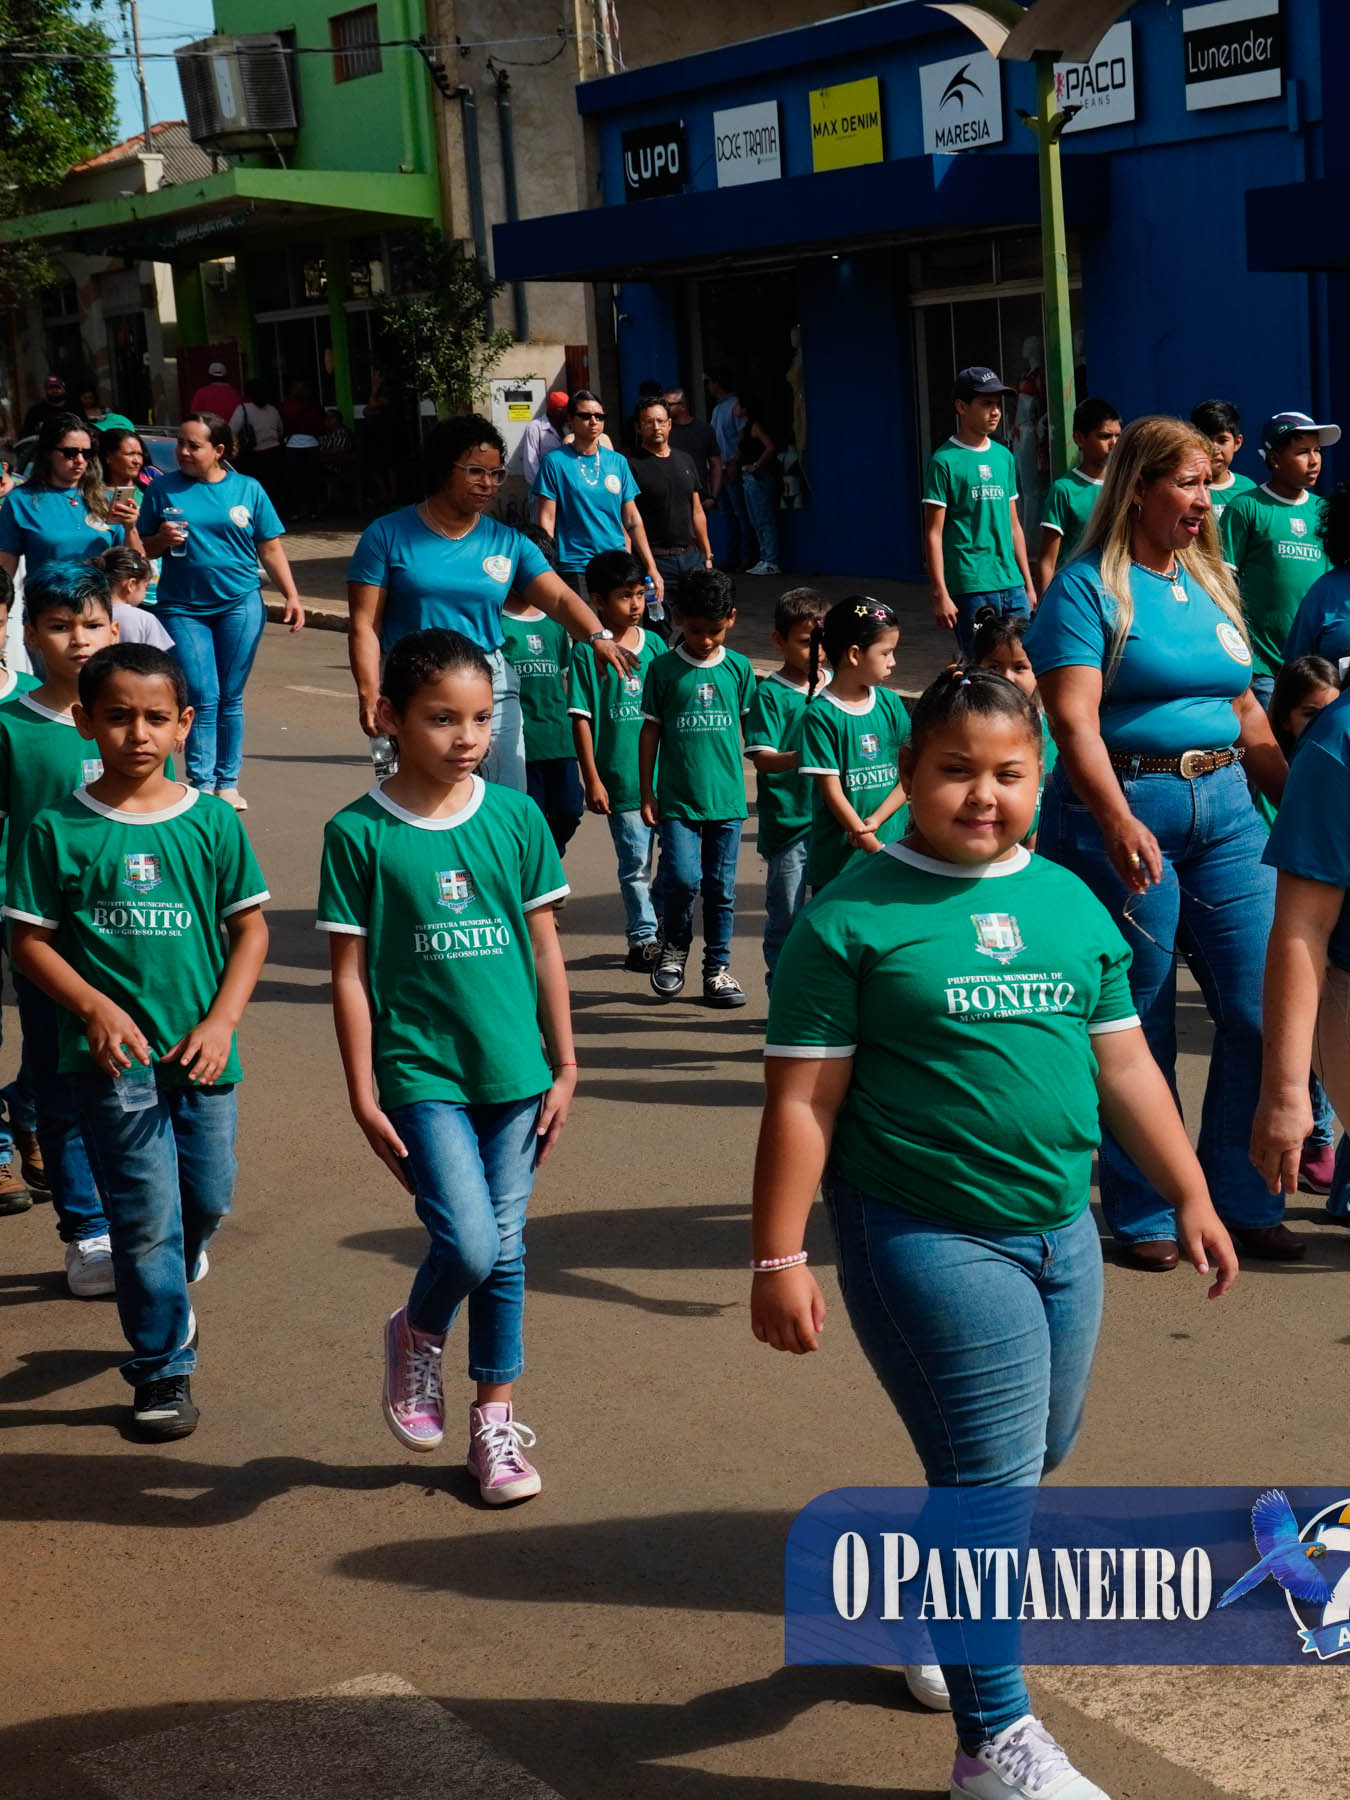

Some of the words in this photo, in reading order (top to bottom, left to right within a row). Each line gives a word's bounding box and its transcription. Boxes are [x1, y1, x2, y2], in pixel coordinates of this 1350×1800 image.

[1188, 30, 1273, 73] Lunender
[1065, 57, 1126, 100] PACO
[813, 116, 838, 139] MAX
[841, 111, 879, 133] DENIM
[935, 119, 991, 148] MARESIA
[716, 131, 742, 162] DOCE
[742, 126, 778, 158] TRAMA
[624, 142, 680, 188] LUPO
[1277, 543, 1321, 559] BONITO
[676, 714, 732, 729] BONITO
[845, 766, 897, 787] BONITO
[91, 907, 192, 929] BONITO
[413, 925, 510, 953] BONITO
[946, 974, 1002, 985] PREFEITURA
[1002, 972, 1049, 982] MUNICIPAL
[1050, 971, 1063, 980] DE
[943, 981, 1076, 1014] BONITO
[960, 1011, 991, 1022] MATO
[993, 1007, 1033, 1019] GROSSO
